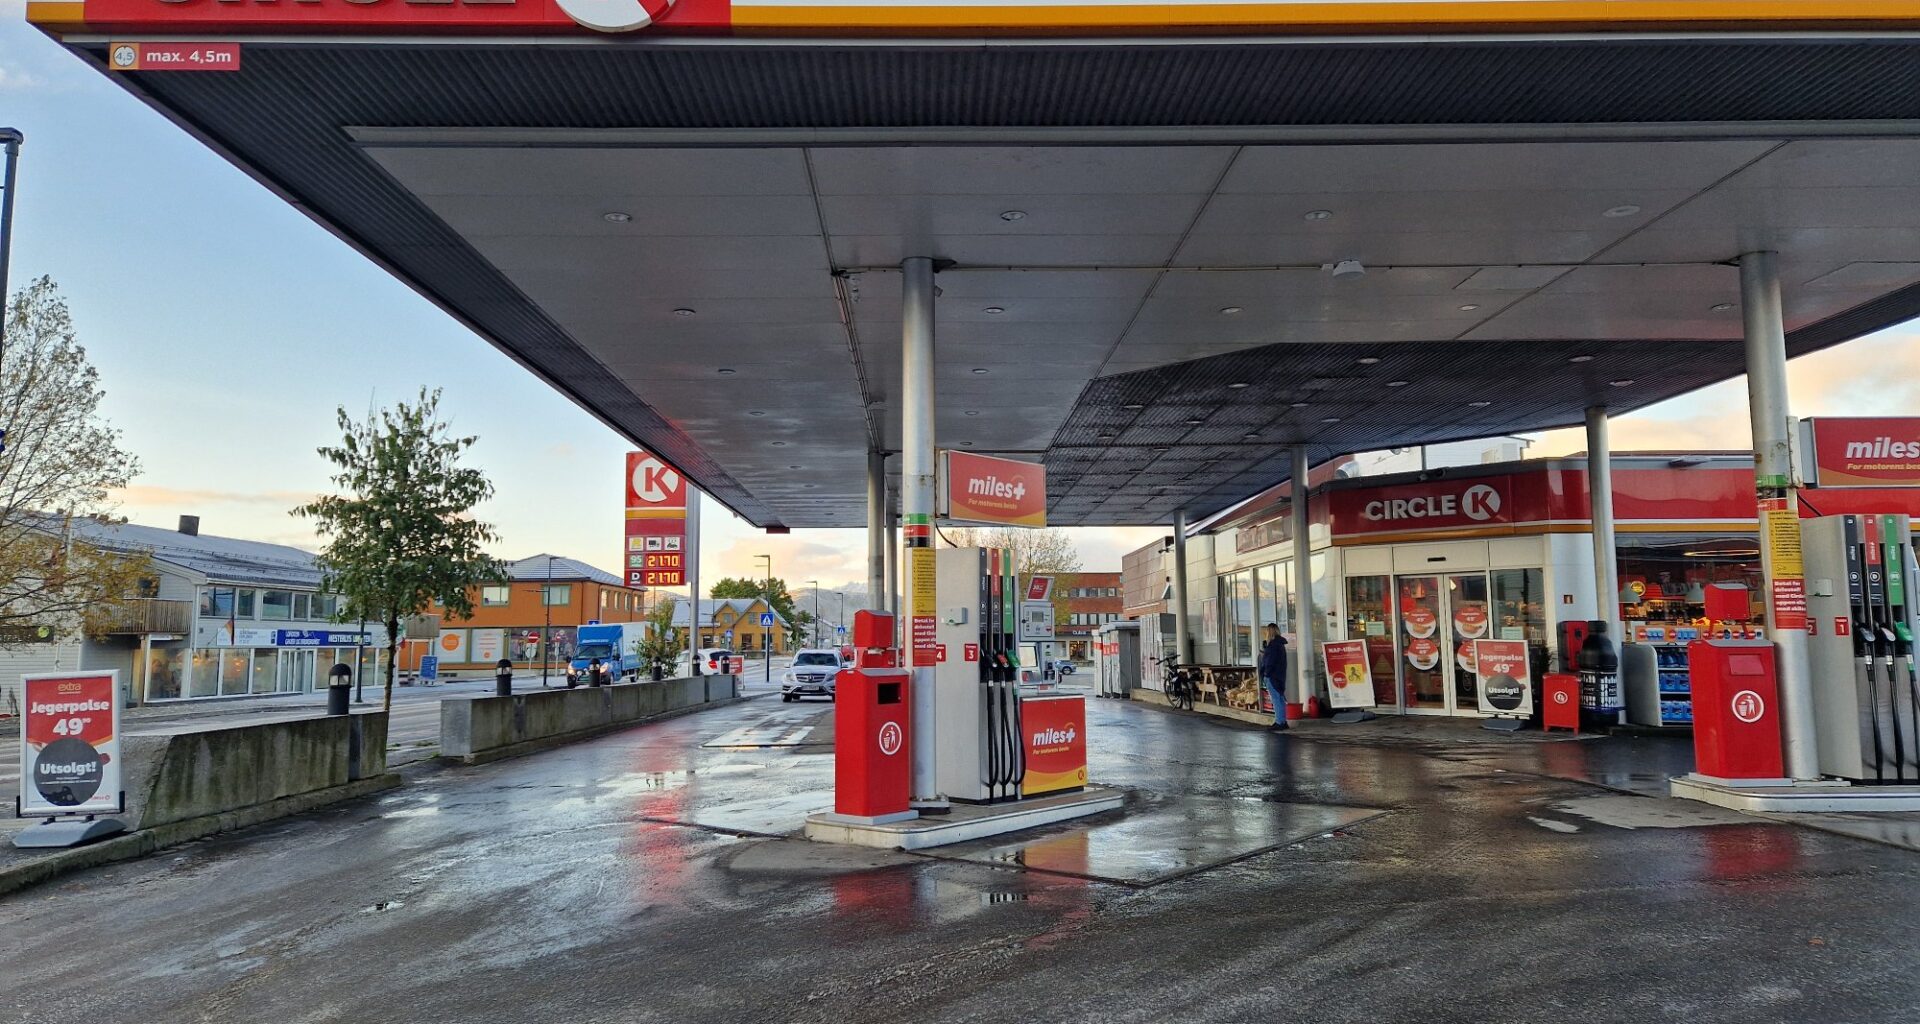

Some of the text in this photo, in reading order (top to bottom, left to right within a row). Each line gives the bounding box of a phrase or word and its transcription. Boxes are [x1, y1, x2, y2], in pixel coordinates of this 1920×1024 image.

[146, 50, 232, 64] max. 4,5m
[1365, 495, 1456, 520] CIRCLE
[936, 651, 943, 660] 4
[968, 650, 974, 660] 3
[30, 699, 110, 715] Jegerpølse
[1032, 728, 1076, 746] miles+
[40, 761, 96, 776] Utsolgt!
